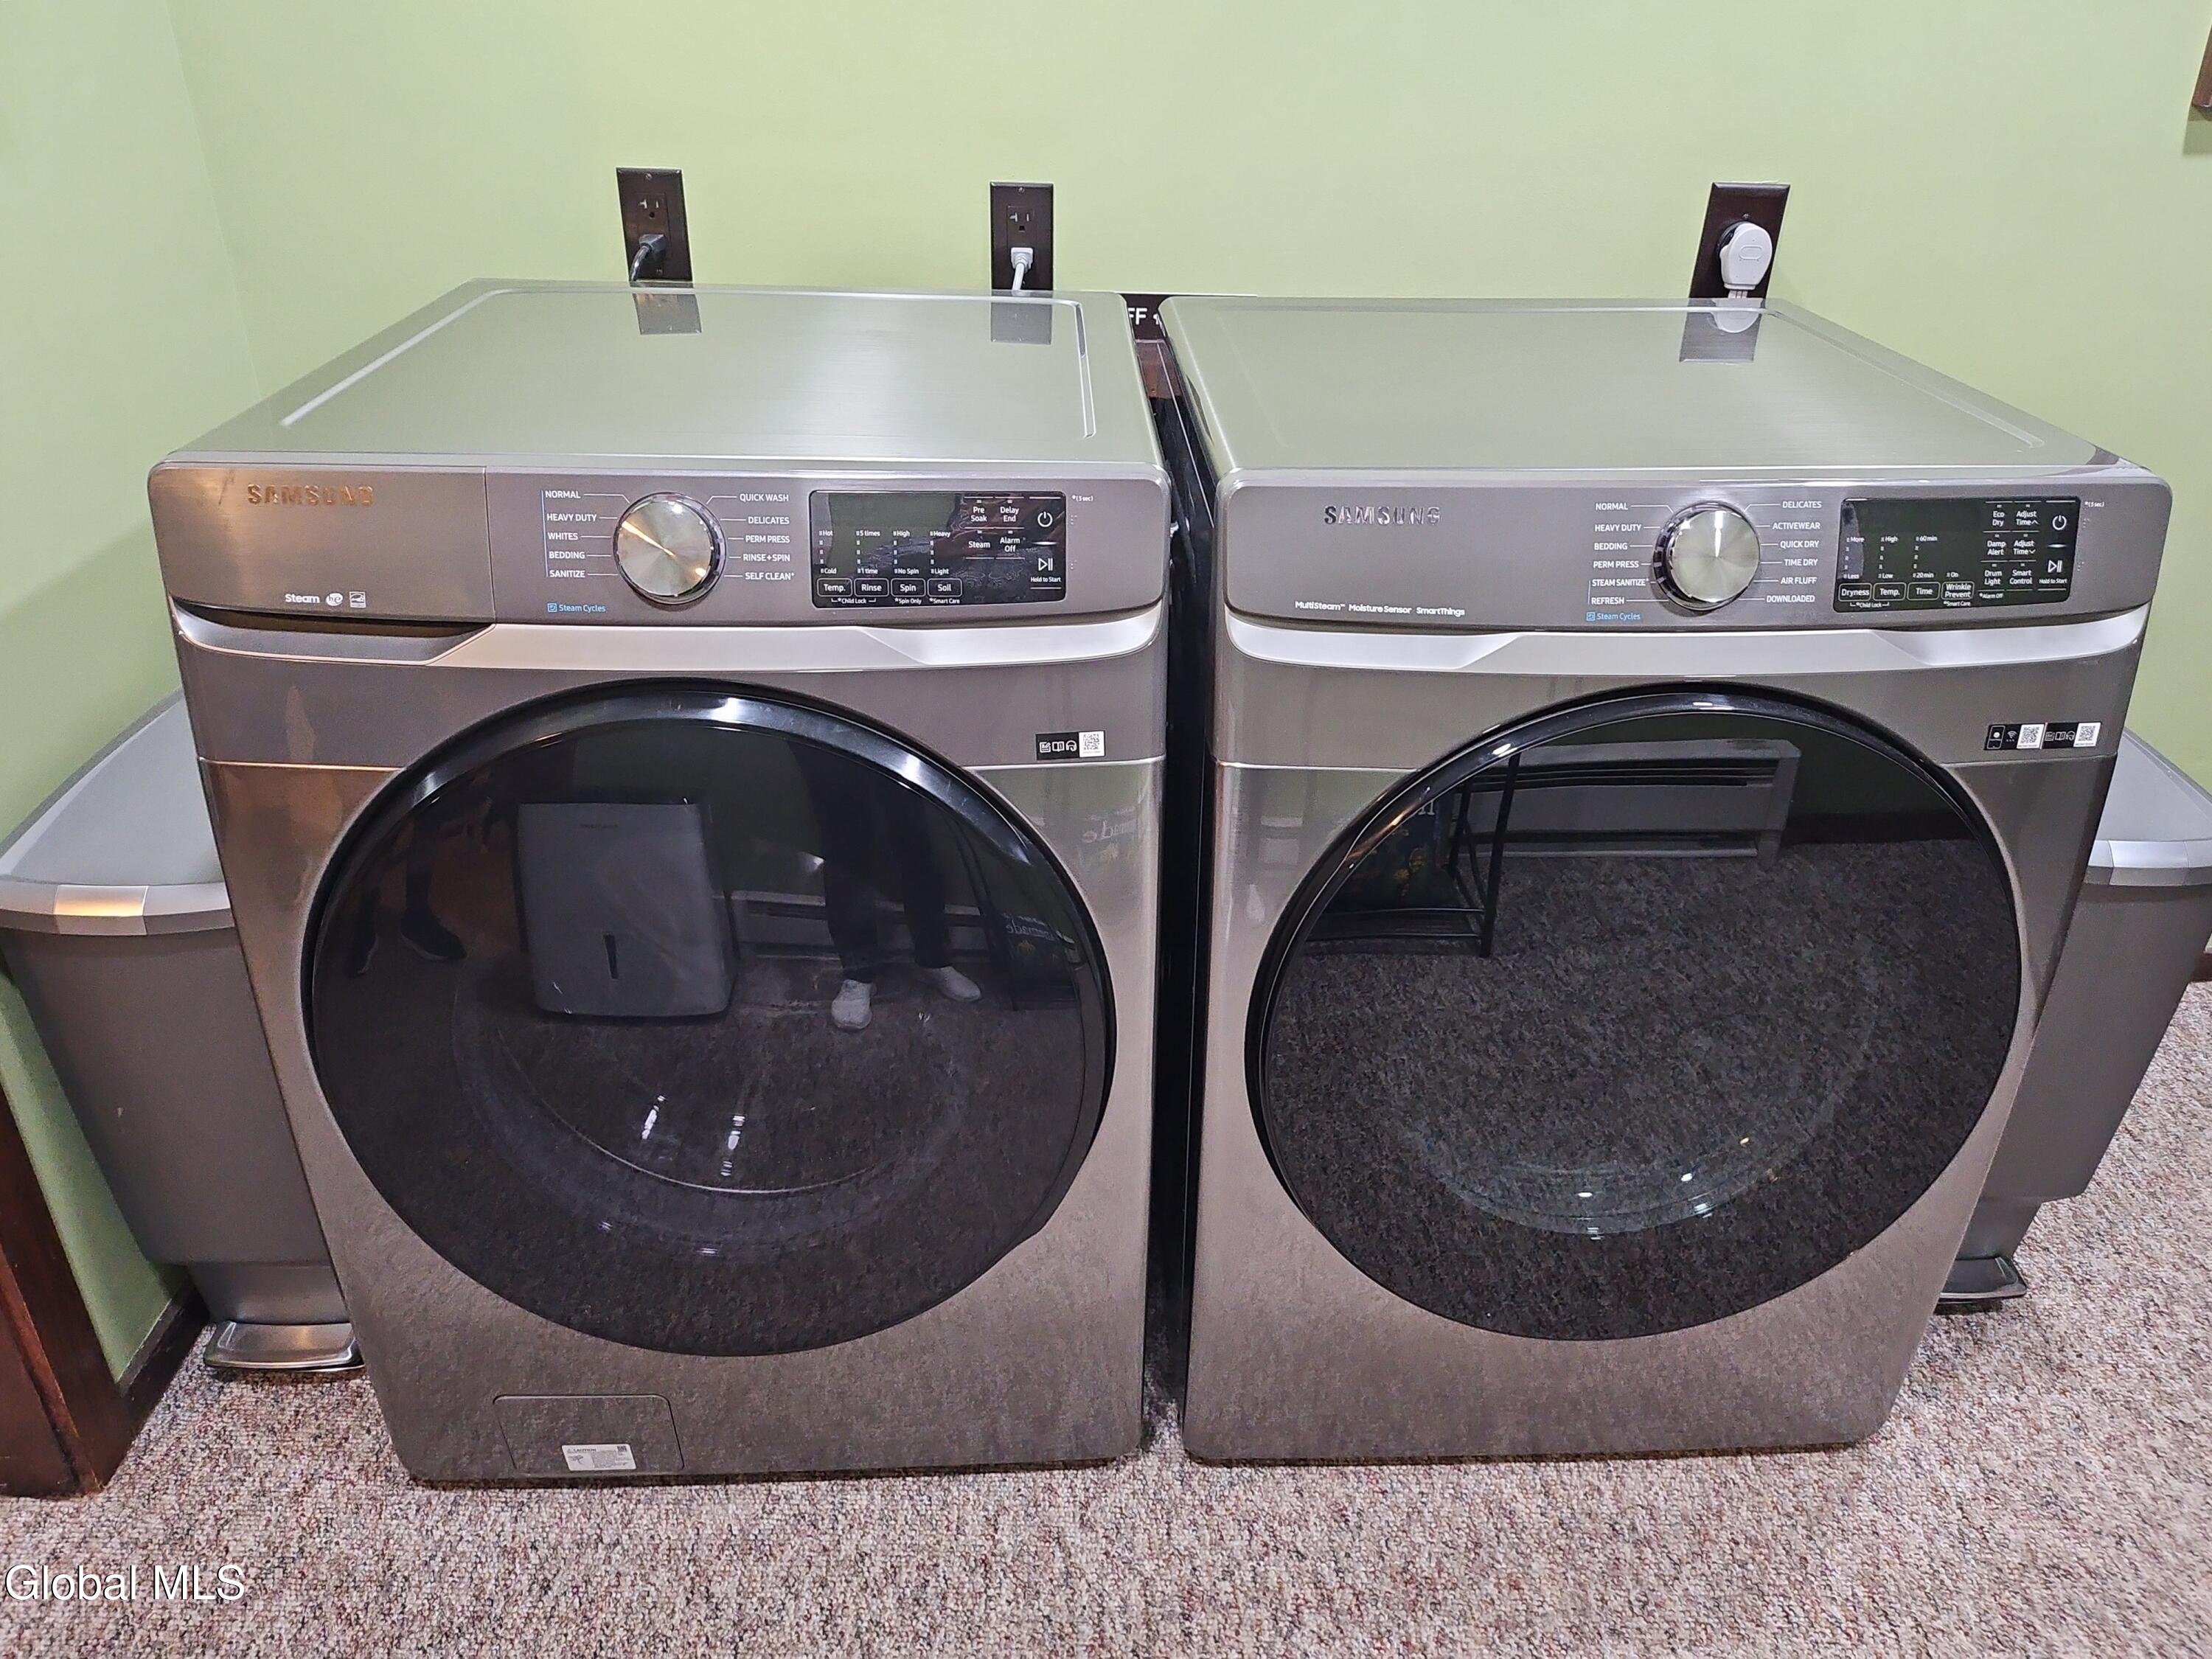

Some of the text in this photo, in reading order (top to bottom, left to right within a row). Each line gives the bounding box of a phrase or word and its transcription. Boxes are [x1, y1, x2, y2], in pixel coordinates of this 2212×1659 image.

[247, 484, 375, 505] SAMSUNG
[545, 490, 581, 498] NORMAL
[740, 493, 789, 503] QUICK WASH
[1596, 503, 1628, 511] NORMAL
[1782, 501, 1822, 509] DELICATES
[973, 506, 984, 514] Pre
[1000, 506, 1019, 515] Delay
[2016, 510, 2037, 518] Adjust
[546, 514, 597, 522] HEAVY DUTY
[1324, 506, 1440, 525] SAMSUNG
[748, 516, 790, 524] DELICATES
[1992, 519, 2004, 527] Dry
[1595, 524, 1641, 532] HEAVY DUTY
[1772, 522, 1820, 530] ACTIVEWEAR
[548, 532, 578, 540] WHITES
[745, 535, 790, 543] PERM PRESS
[968, 540, 991, 549] Steam
[1594, 543, 1628, 551] BEDDING
[1780, 540, 1820, 549] QUICK DRY
[2014, 540, 2034, 548] Adjust
[549, 552, 585, 560] BEDDING
[1593, 560, 1639, 568] PERM PRESS
[549, 570, 585, 578] SANITIZE
[745, 572, 765, 580] SELF
[1592, 579, 1615, 587] STEAM
[1792, 577, 1818, 585] FLUFF
[1984, 578, 2001, 586] Light
[824, 583, 846, 593] Temp.
[861, 583, 882, 591] Rinse
[900, 583, 917, 593] Spin
[938, 583, 952, 591] Soil
[1841, 588, 1870, 597] Dryness
[1879, 588, 1900, 597] Temp.
[285, 594, 320, 603] Steam
[1591, 597, 1624, 605] REFRESH
[1766, 595, 1815, 603] DOWNLOADED
[559, 605, 606, 613] Steam Cycles
[1349, 604, 1383, 613] Moisture
[1383, 605, 1412, 614] Sensor
[1416, 607, 1465, 617] SmartThings
[1619, 613, 1641, 622] Cycles
